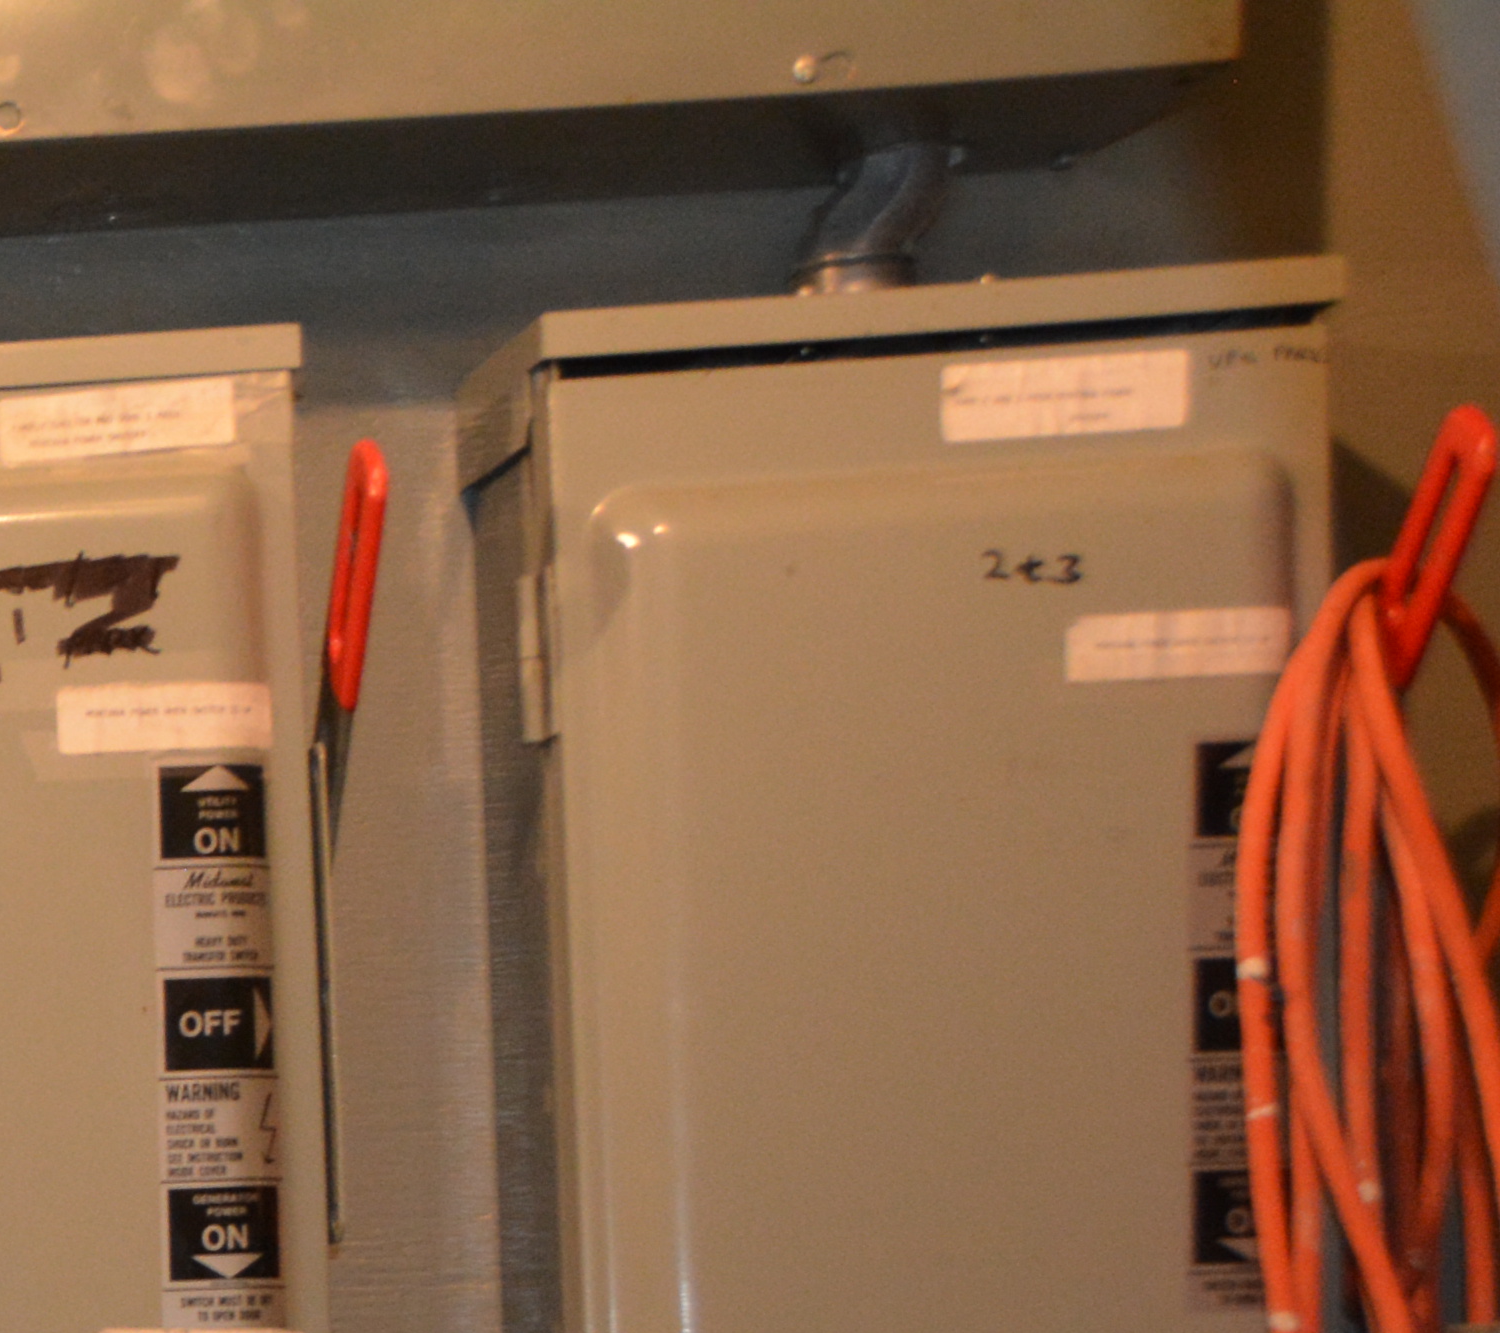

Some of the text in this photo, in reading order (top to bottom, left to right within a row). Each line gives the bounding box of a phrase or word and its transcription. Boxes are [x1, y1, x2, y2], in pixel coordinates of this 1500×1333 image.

[193, 826, 241, 855] ON
[178, 1009, 242, 1038] OFF
[166, 1082, 241, 1102] WARNING
[201, 1223, 248, 1251] ON
